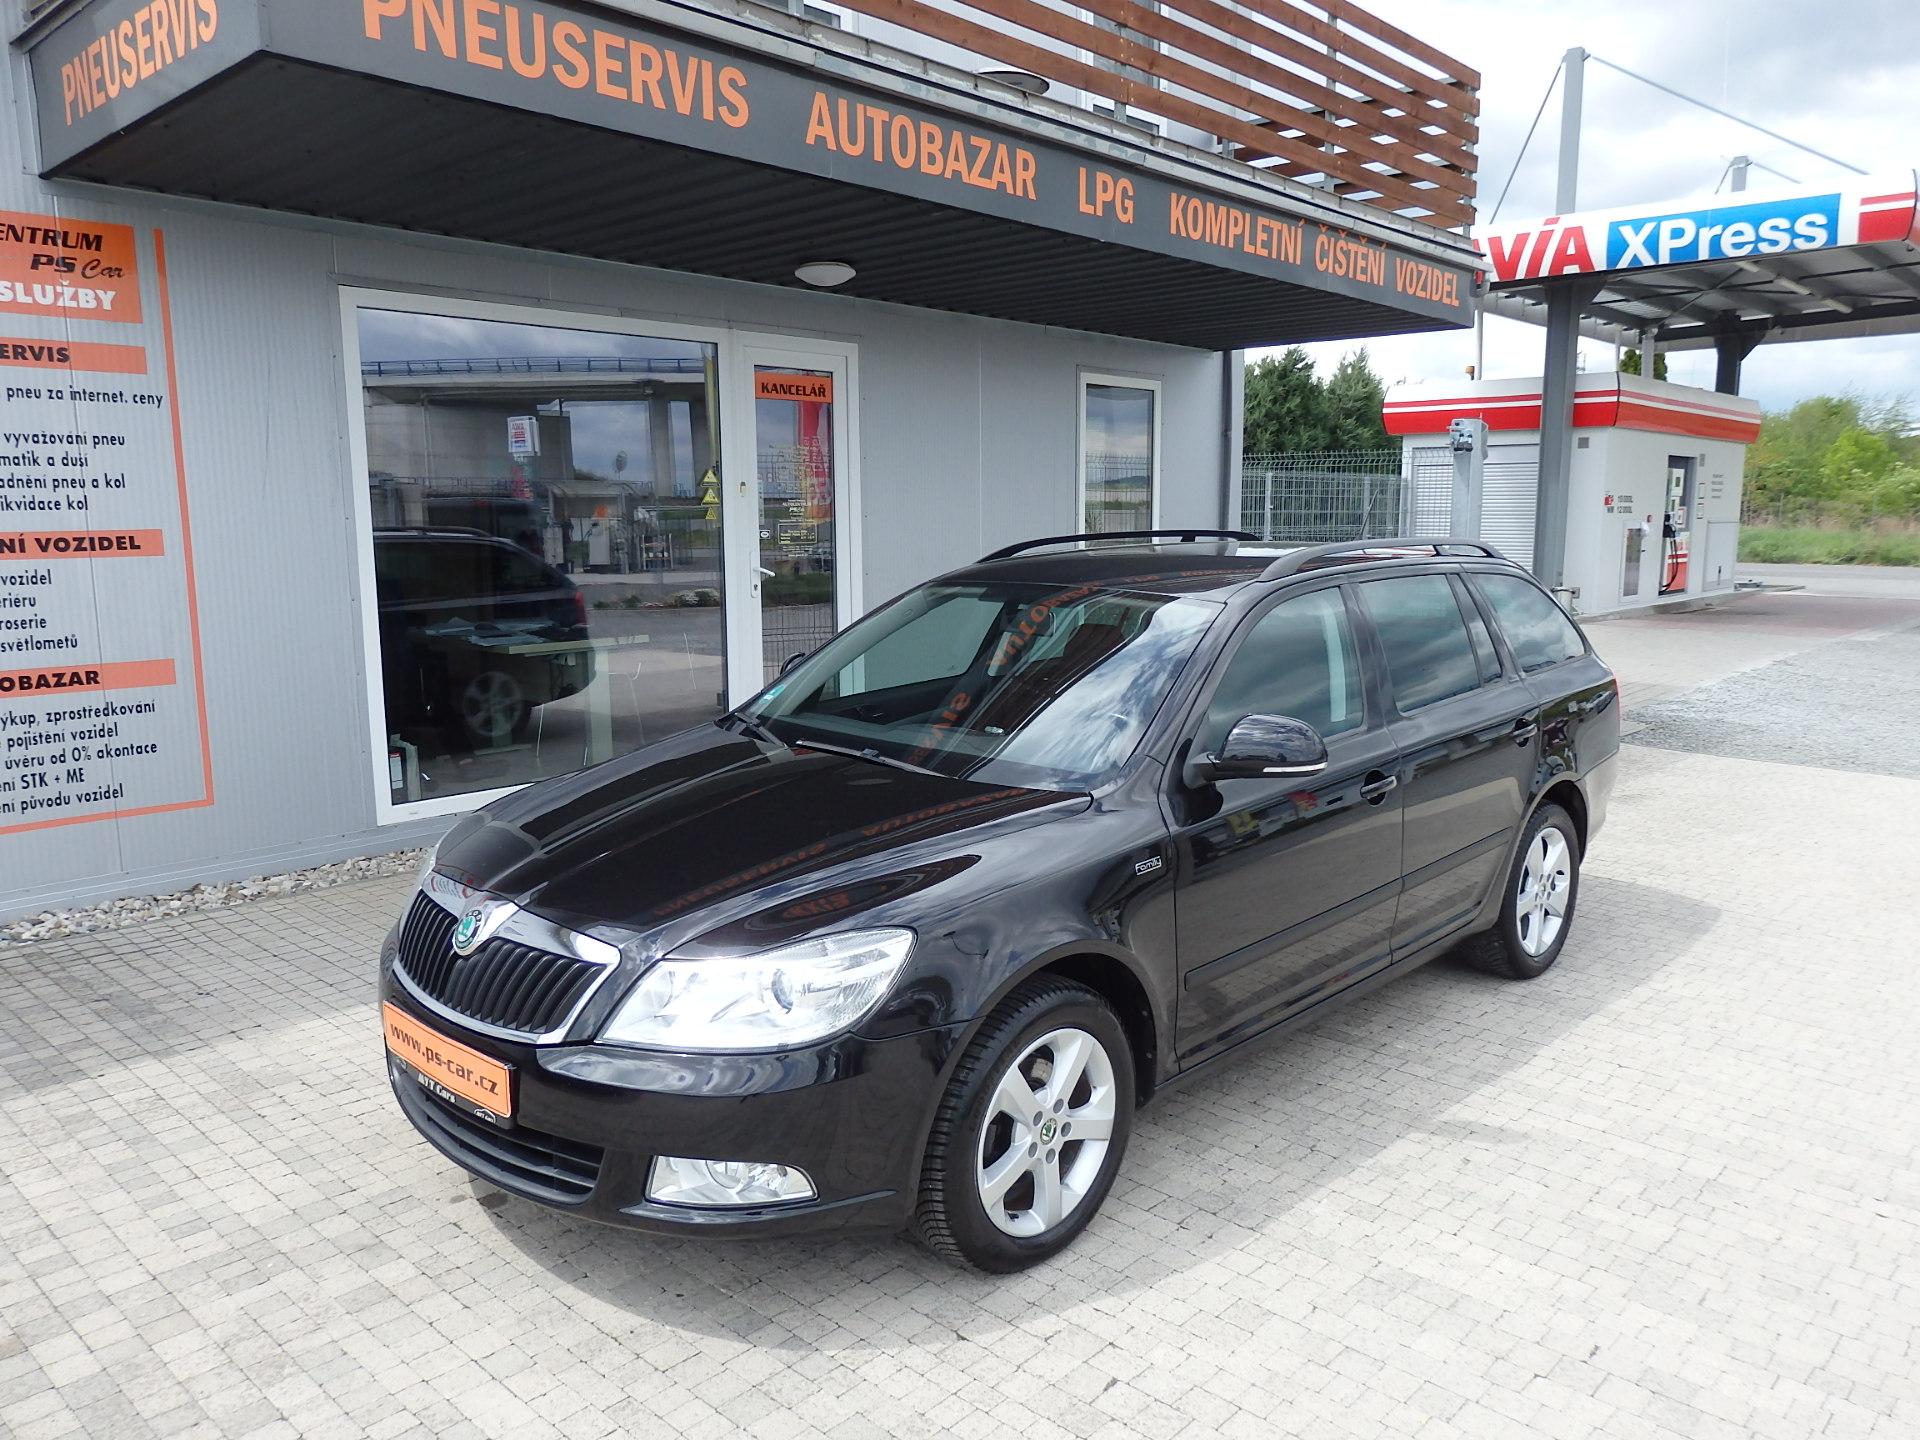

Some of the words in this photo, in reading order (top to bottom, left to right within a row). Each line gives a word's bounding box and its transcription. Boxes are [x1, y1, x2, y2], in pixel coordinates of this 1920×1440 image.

[61, 0, 218, 126] PNEUSERVIS
[363, 0, 750, 128] PNEUSERVIS
[805, 91, 1037, 201] AUTOBAZAR
[1079, 166, 1135, 224] LPG
[1169, 192, 1308, 266] KOMPLETNÍ
[1314, 223, 1389, 287] ČIŠTĚNÍ
[1396, 257, 1460, 307] VOZIDEL
[1616, 213, 1829, 270] XPress
[31, 253, 77, 273] PS
[81, 258, 125, 279] Car
[0, 279, 116, 311] SLUŽBY
[6, 386, 42, 402] pneu
[47, 388, 64, 401] za
[69, 384, 128, 404] internet.
[132, 392, 163, 409] ceny
[761, 382, 827, 398] KANCELÁŘ
[4, 430, 88, 448] vyvažování
[92, 434, 126, 449] pneu
[46, 455, 55, 467] a
[52, 476, 86, 492] pneu
[91, 476, 99, 489] a
[104, 472, 126, 489] kol
[67, 494, 88, 511] kol
[34, 535, 142, 553] VOZIDEL
[0, 568, 53, 586] vozidel
[0, 633, 78, 653] světlometů
[46, 699, 156, 726] zprostředkování
[7, 728, 66, 752] pojištění
[70, 721, 119, 742] vozidel
[5, 755, 45, 770] úvěru
[50, 747, 67, 765] od
[71, 745, 92, 762] 0%
[96, 743, 158, 760] akontace
[20, 772, 49, 790] STK
[66, 767, 85, 784] ME
[21, 791, 71, 815] původu
[75, 783, 124, 804] vozidel
[390, 1023, 499, 1096] www.ps-car.cz
